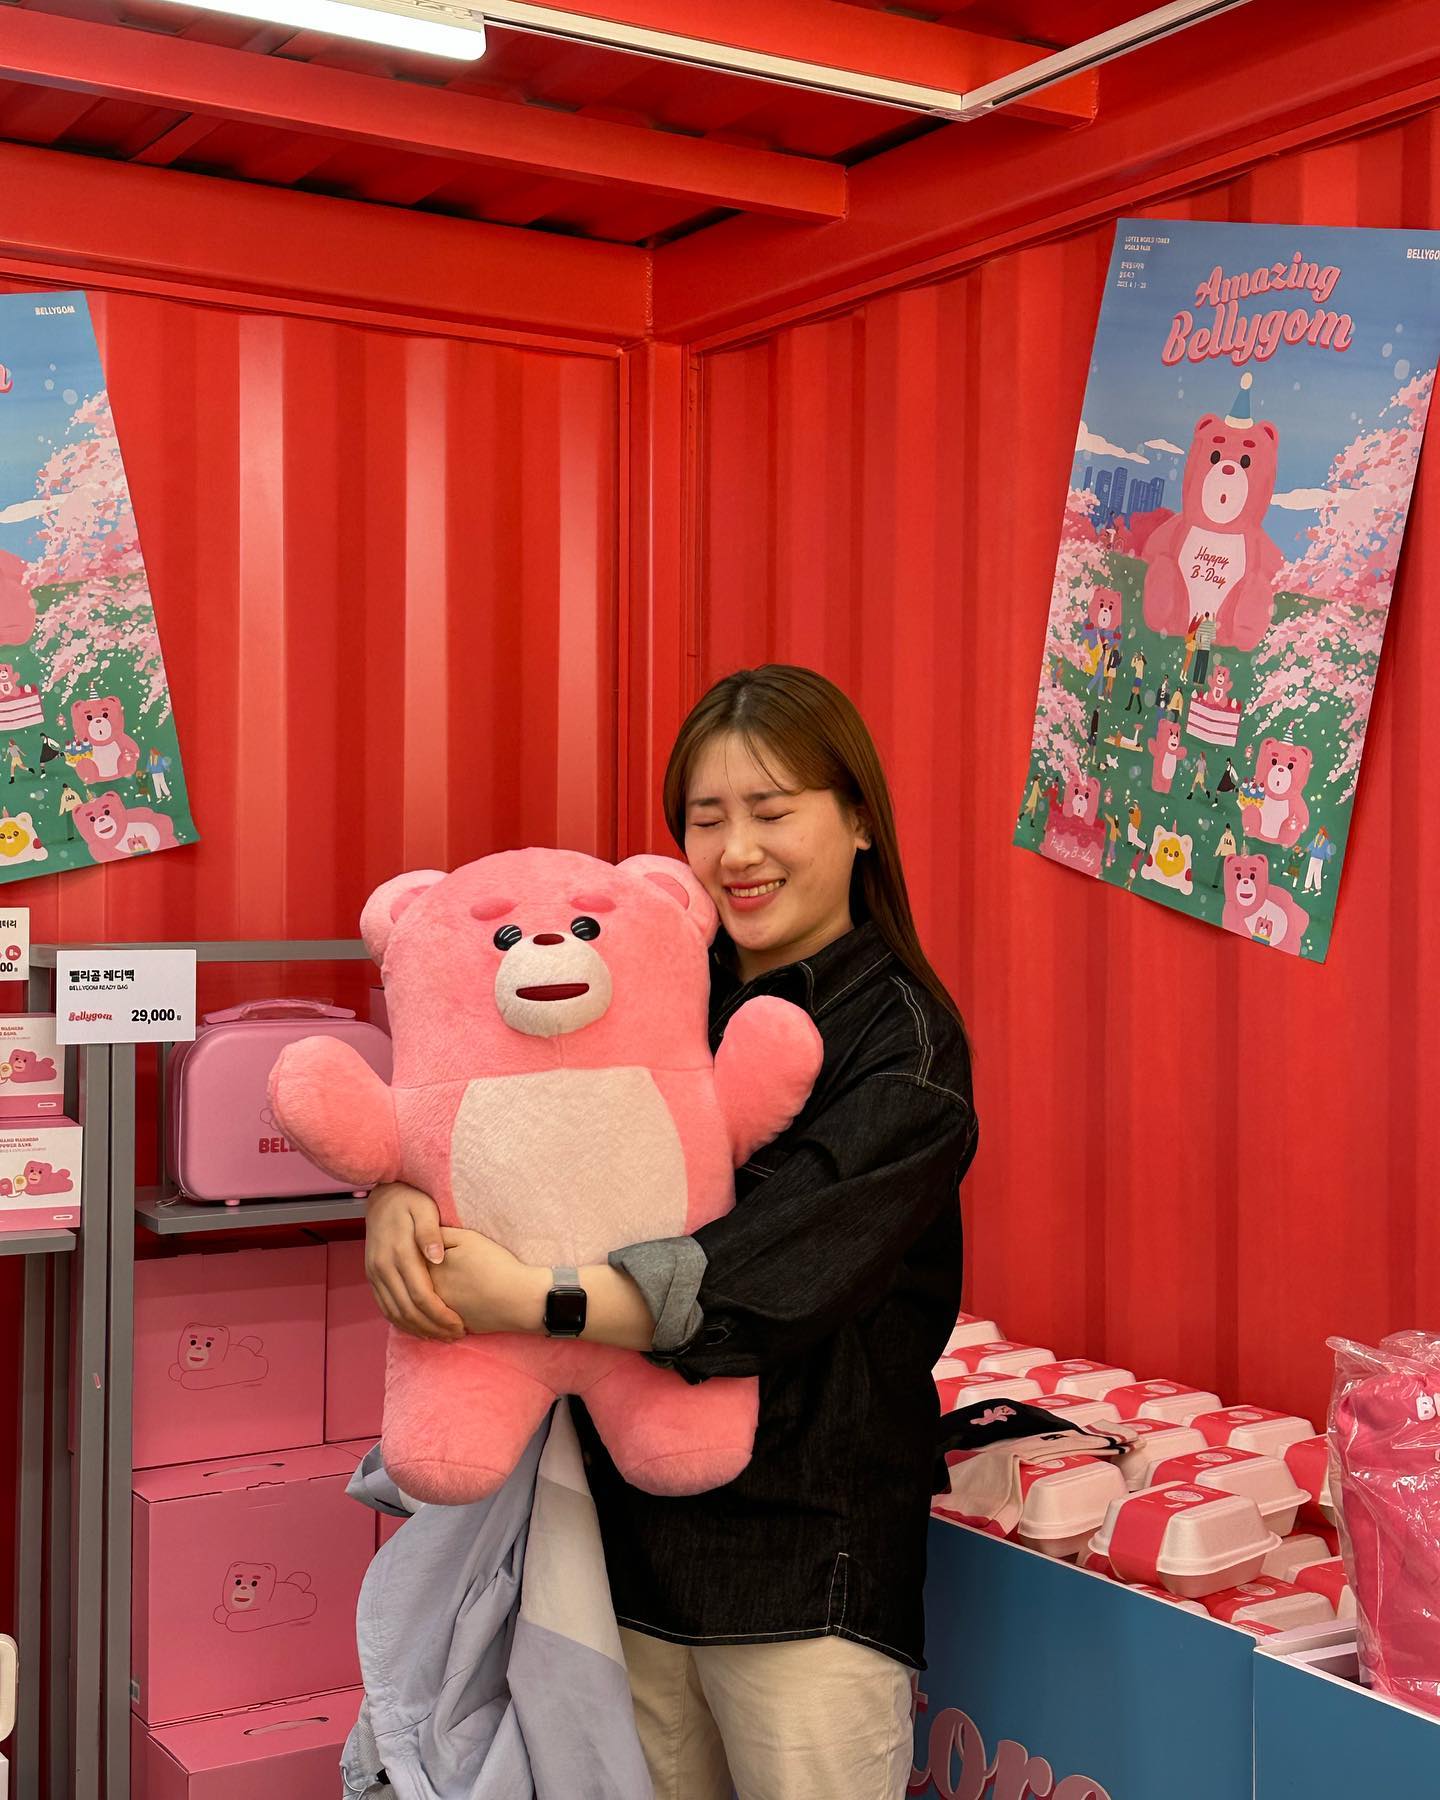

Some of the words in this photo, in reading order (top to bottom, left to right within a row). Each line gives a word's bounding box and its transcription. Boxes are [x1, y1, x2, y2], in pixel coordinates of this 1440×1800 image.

[1406, 248, 1440, 260] BELLYGO
[1195, 251, 1341, 307] Amazing
[1161, 300, 1353, 366] Bellygom
[1194, 546, 1229, 569] Happy
[1190, 564, 1226, 589] B-Day
[68, 1010, 113, 1022] Bellygom
